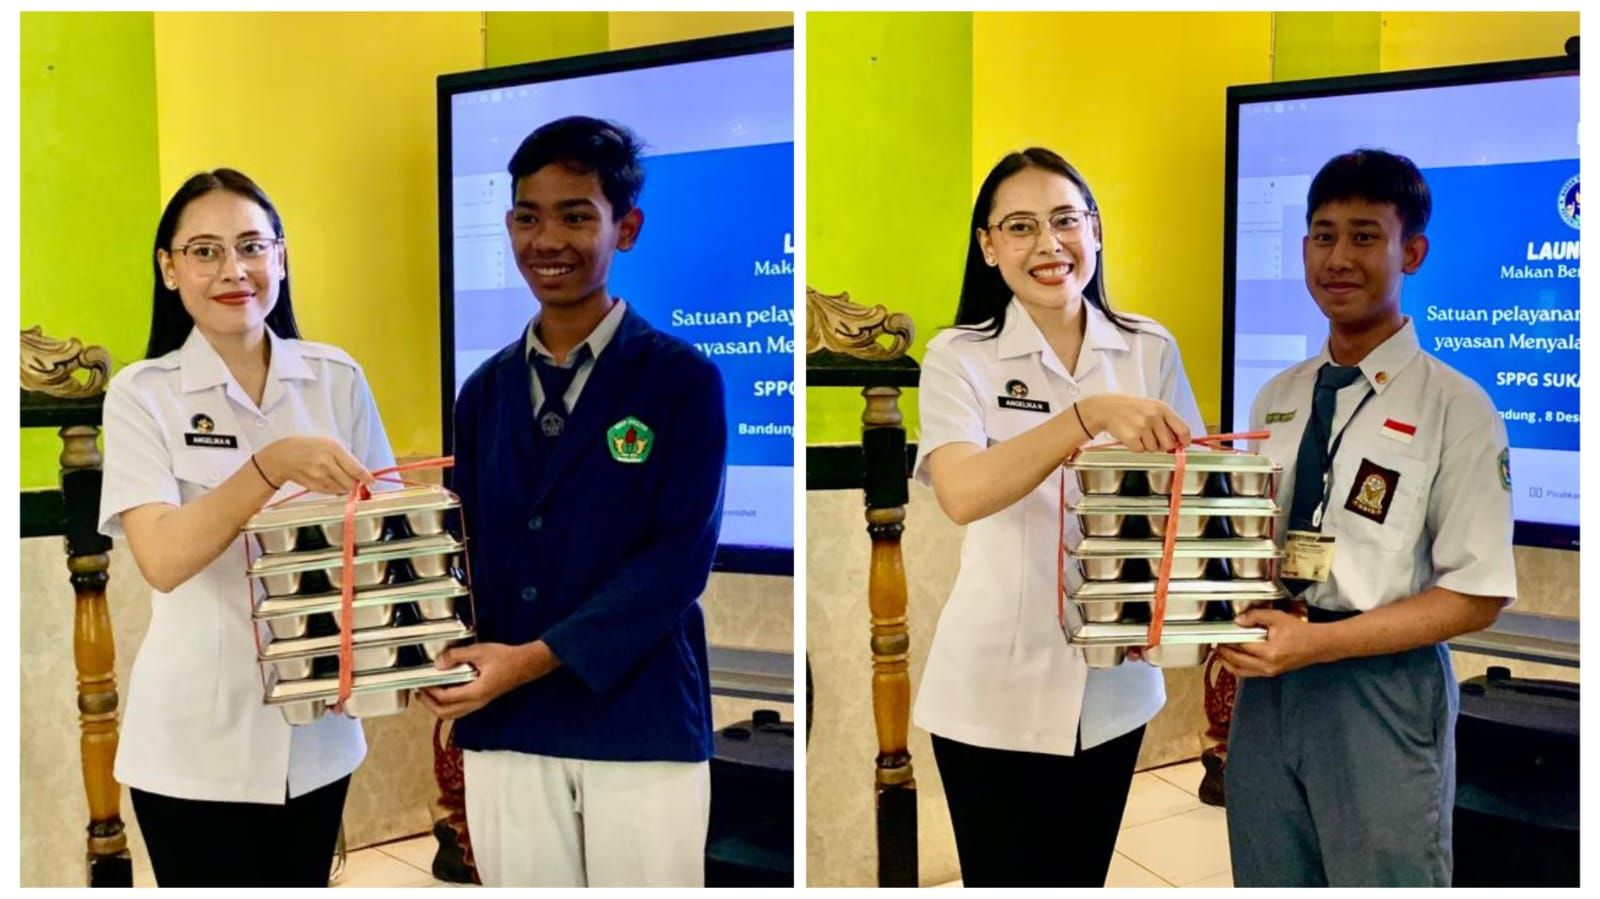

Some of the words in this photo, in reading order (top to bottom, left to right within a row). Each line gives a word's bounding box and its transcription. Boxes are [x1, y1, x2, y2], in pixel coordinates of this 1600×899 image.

[754, 259, 795, 276] Mak
[1500, 265, 1554, 279] Makan
[671, 308, 742, 327] Satuan
[1426, 305, 1488, 322] Satuan
[1434, 336, 1505, 352] yayasan
[1496, 371, 1539, 387] SPPG
[1545, 411, 1553, 422] 8
